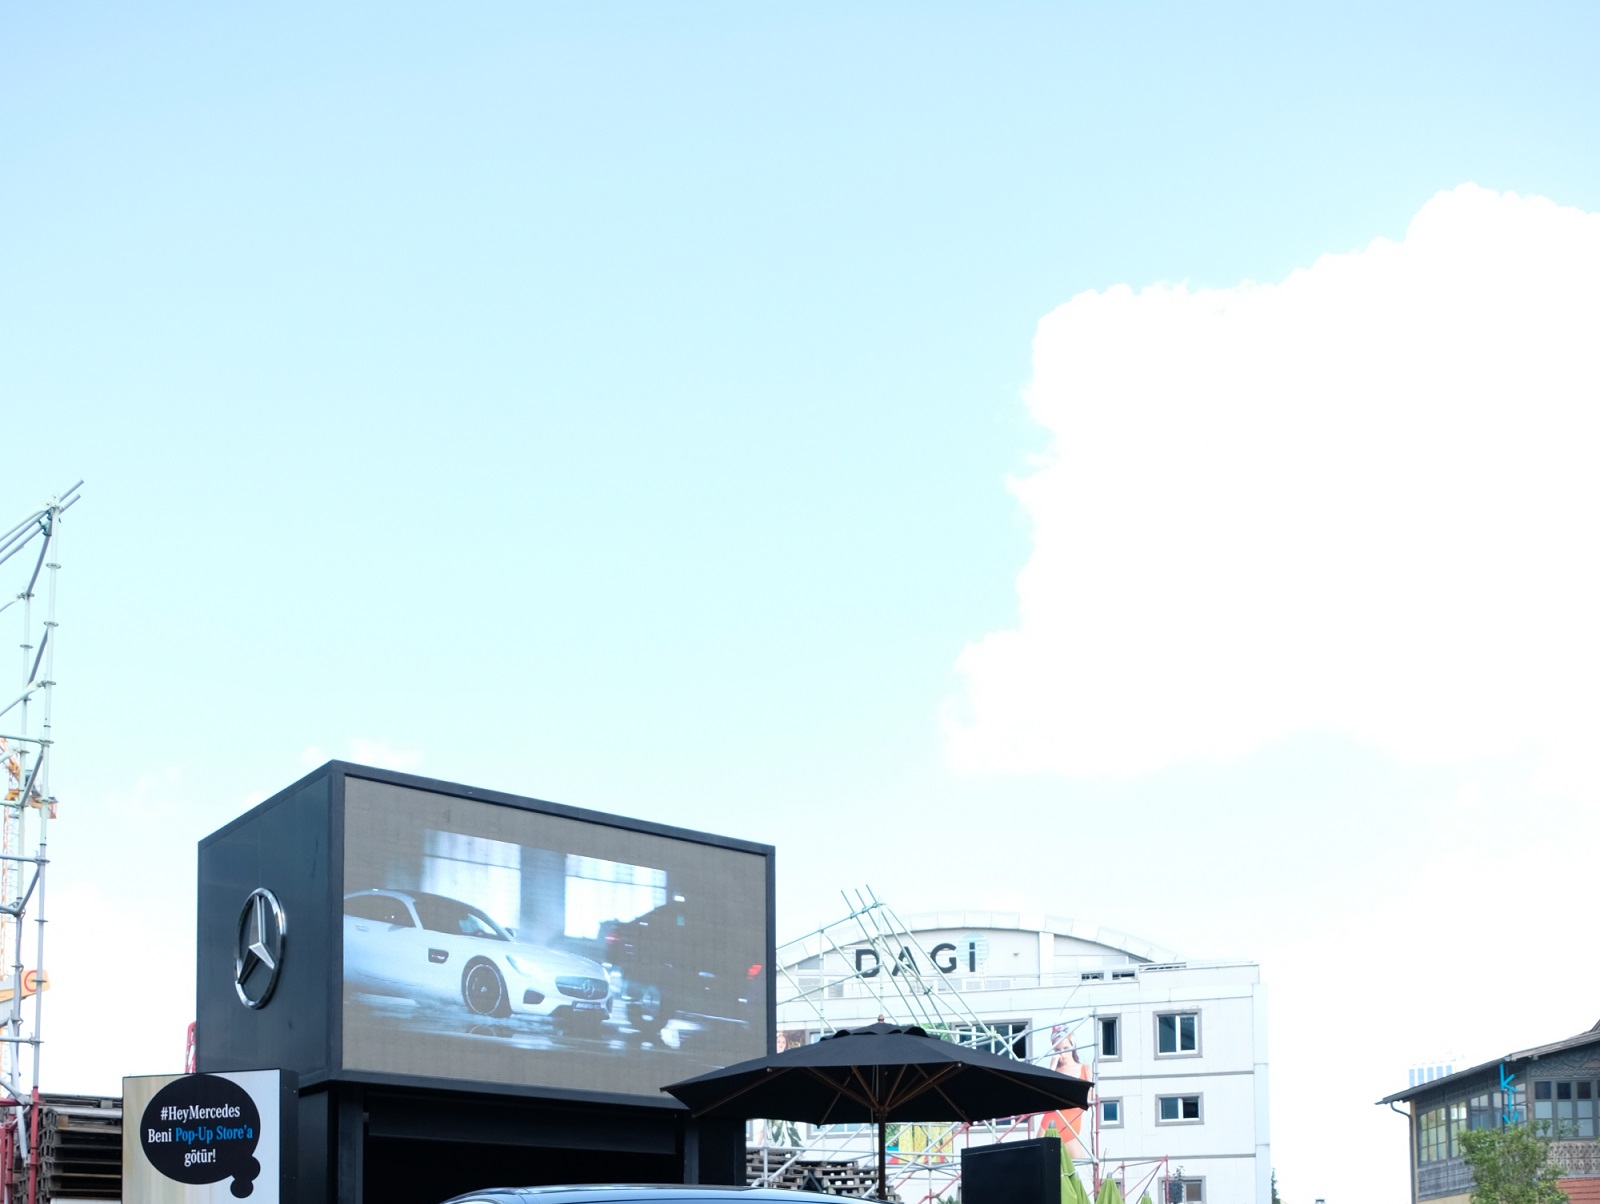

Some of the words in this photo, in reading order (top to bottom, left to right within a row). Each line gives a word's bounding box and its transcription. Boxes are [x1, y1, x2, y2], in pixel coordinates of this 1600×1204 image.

[160, 1104, 241, 1123] #HeyMercedes
[147, 1128, 173, 1143] Beni
[175, 1126, 214, 1145] Pop-Up
[216, 1124, 253, 1140] Store'a
[184, 1149, 216, 1167] götür!
